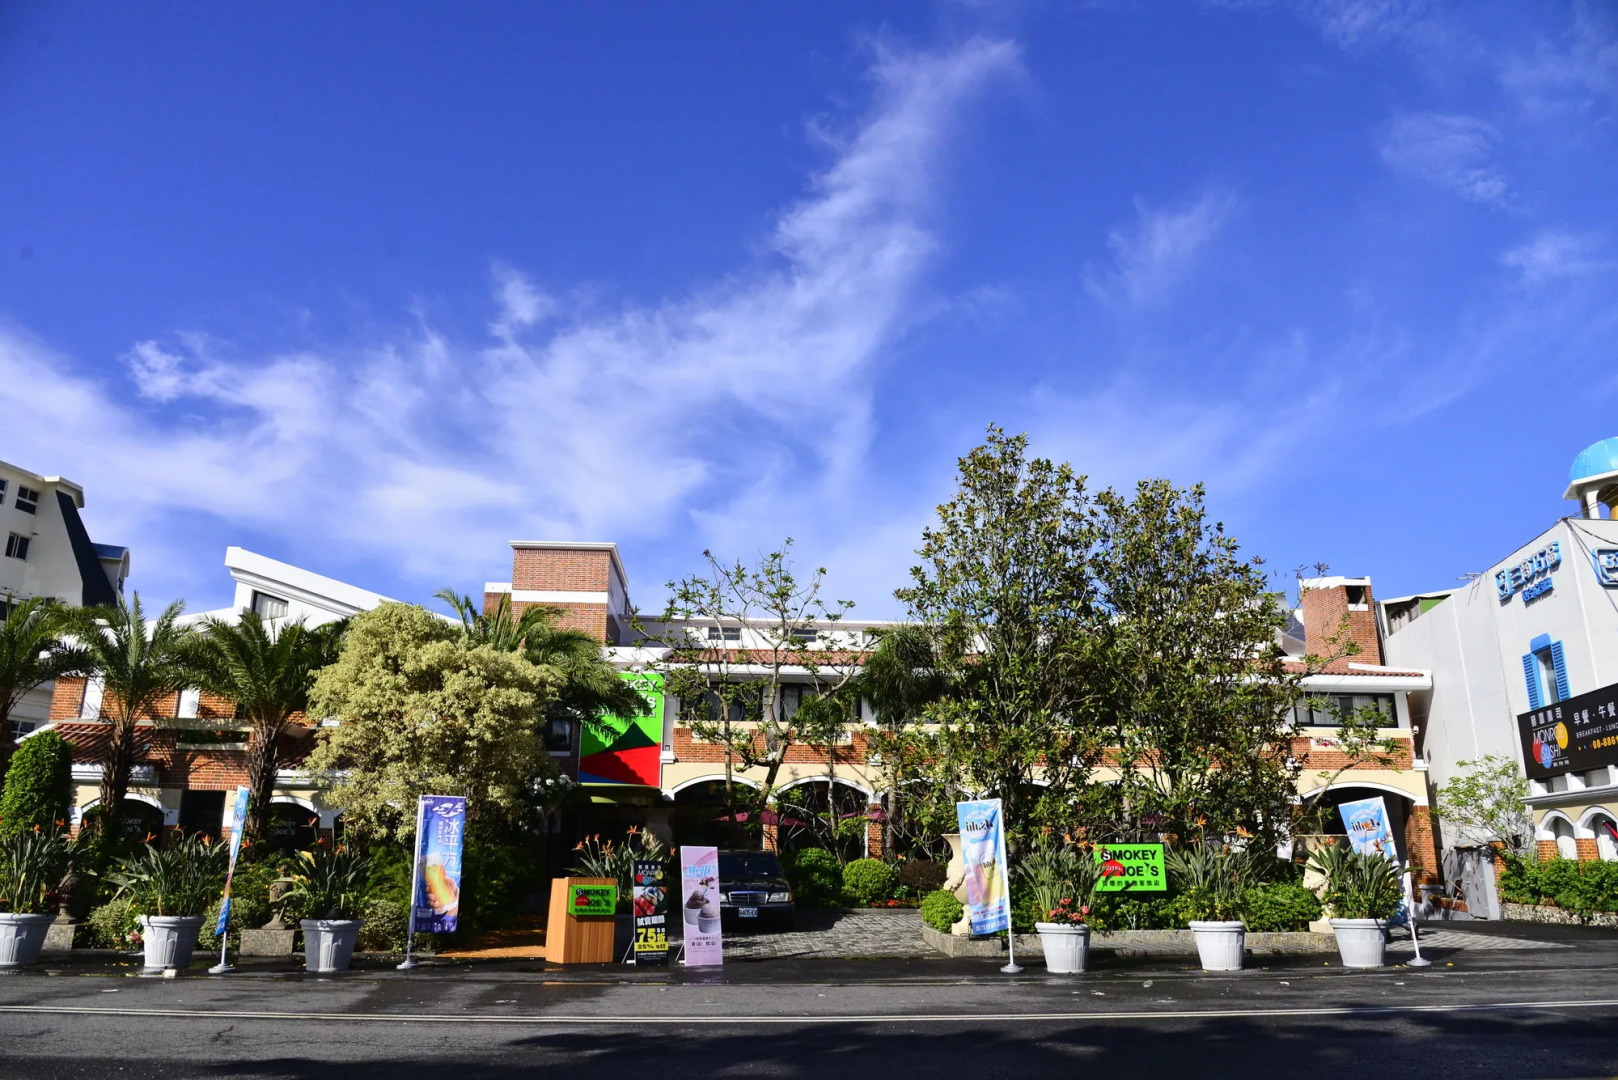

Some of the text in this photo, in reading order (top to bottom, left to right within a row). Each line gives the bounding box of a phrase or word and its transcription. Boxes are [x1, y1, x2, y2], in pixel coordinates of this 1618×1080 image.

[1533, 724, 1564, 745] MONROE
[1576, 726, 1602, 738] BREAKFAST
[1541, 743, 1562, 761] SUSHI
[442, 819, 460, 867] 冰平方
[1101, 849, 1157, 861] SMOKEY
[576, 888, 611, 896] SMOKEY
